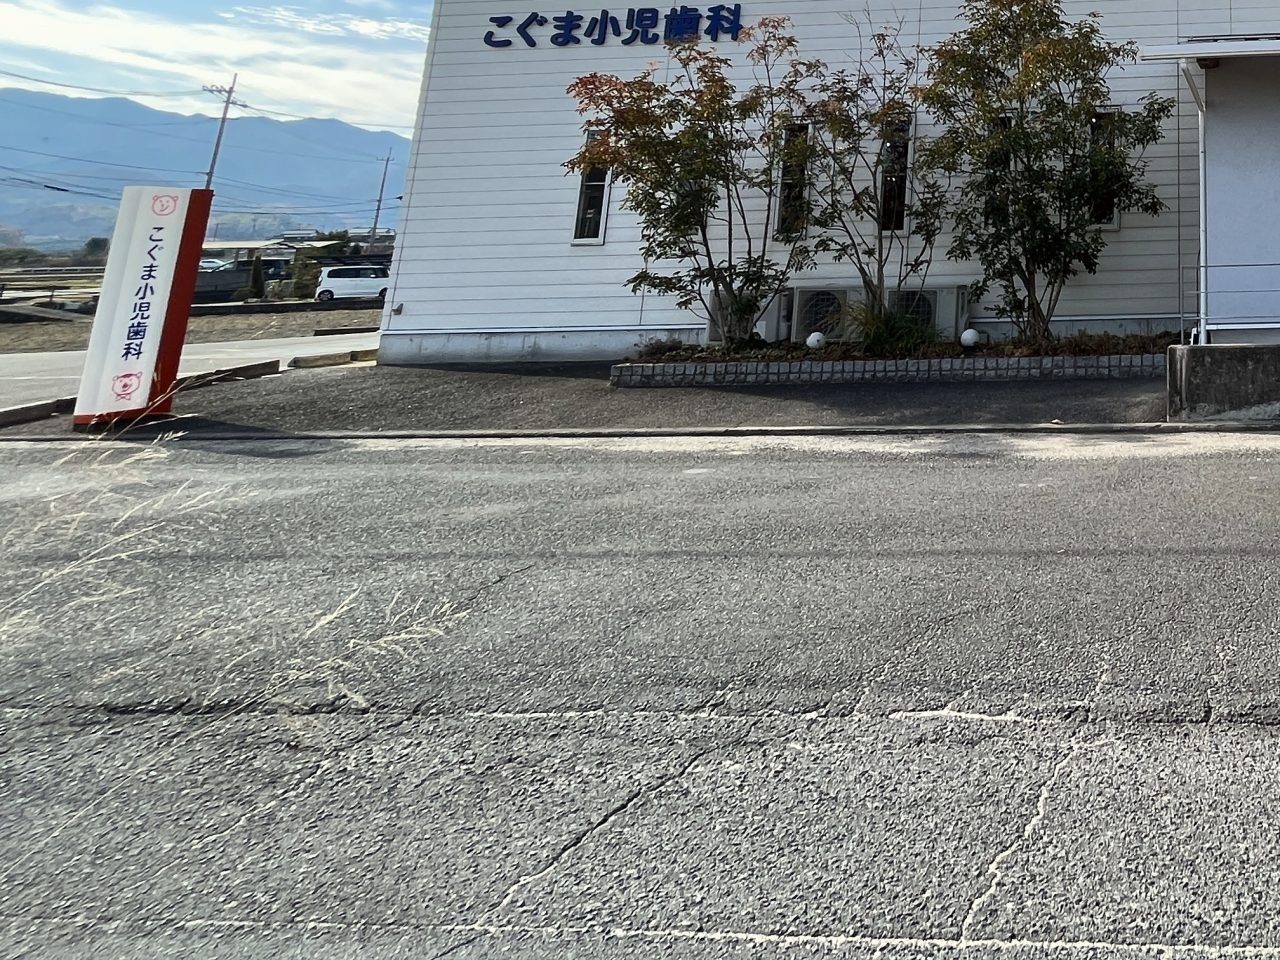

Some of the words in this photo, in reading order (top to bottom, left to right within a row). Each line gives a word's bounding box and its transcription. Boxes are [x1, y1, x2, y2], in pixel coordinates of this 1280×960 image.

[483, 3, 742, 48] こぐま小児歯科
[121, 226, 165, 361] こぐま小児歯科
